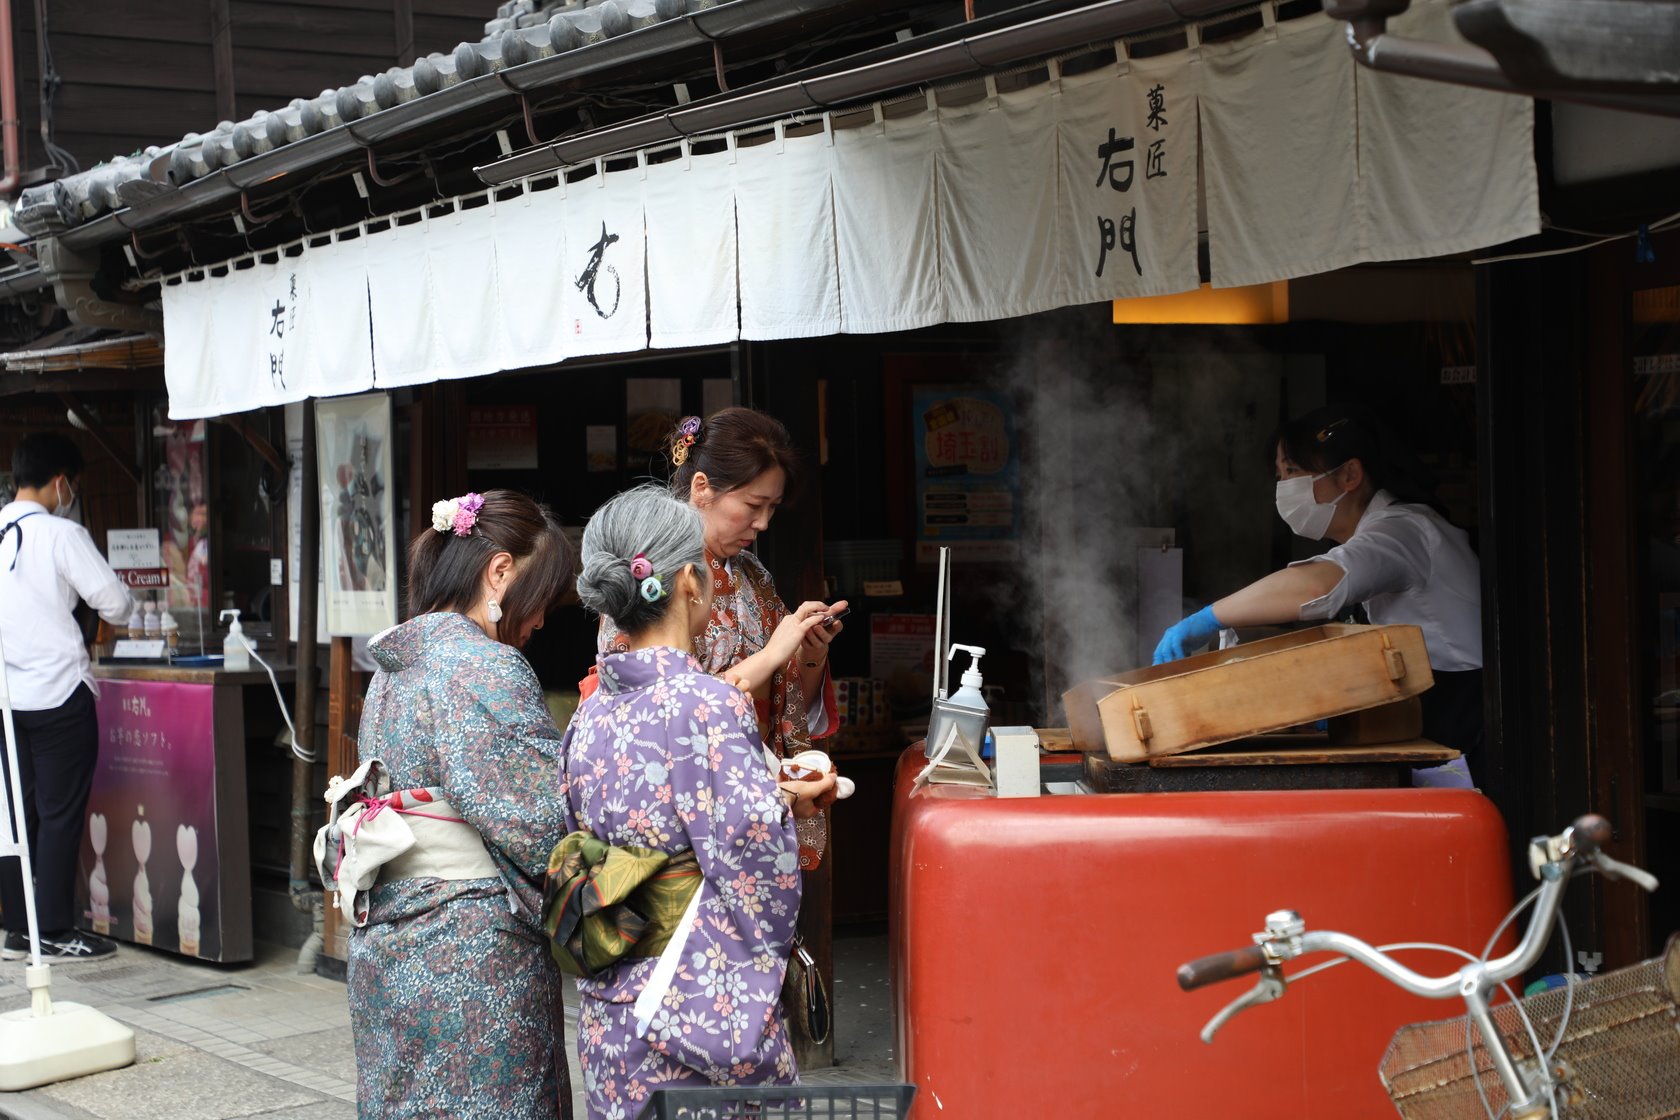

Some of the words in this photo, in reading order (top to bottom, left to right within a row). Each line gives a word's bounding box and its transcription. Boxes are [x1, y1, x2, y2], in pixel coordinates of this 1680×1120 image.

[1146, 83, 1169, 180] 菓匠
[1095, 127, 1142, 278] 右門
[269, 298, 287, 391] 右門
[936, 431, 998, 464] 埼玉割
[127, 570, 160, 585] Cream
